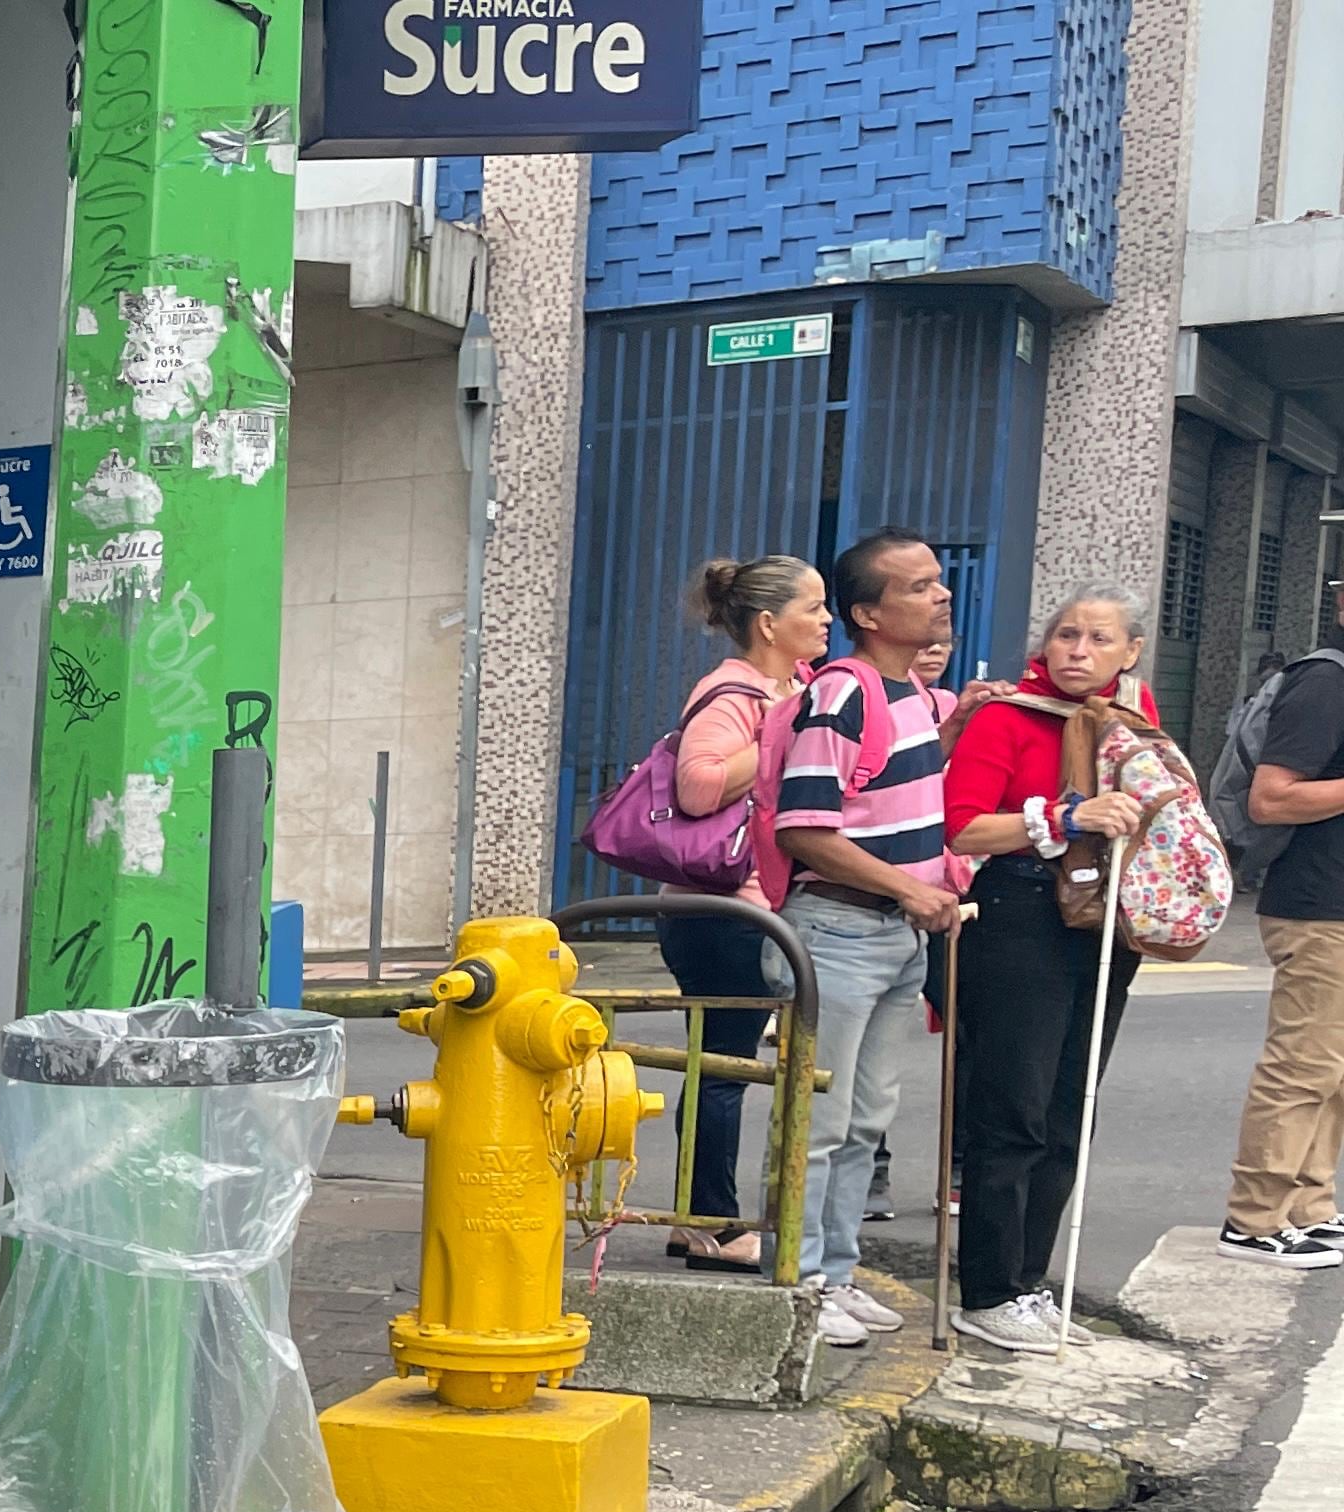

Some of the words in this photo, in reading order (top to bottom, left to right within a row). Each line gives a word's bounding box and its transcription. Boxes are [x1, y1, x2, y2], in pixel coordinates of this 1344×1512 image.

[383, 0, 646, 96] Sucre
[730, 334, 765, 349] CALLE
[766, 333, 775, 346] 1
[8, 555, 37, 570] 7600
